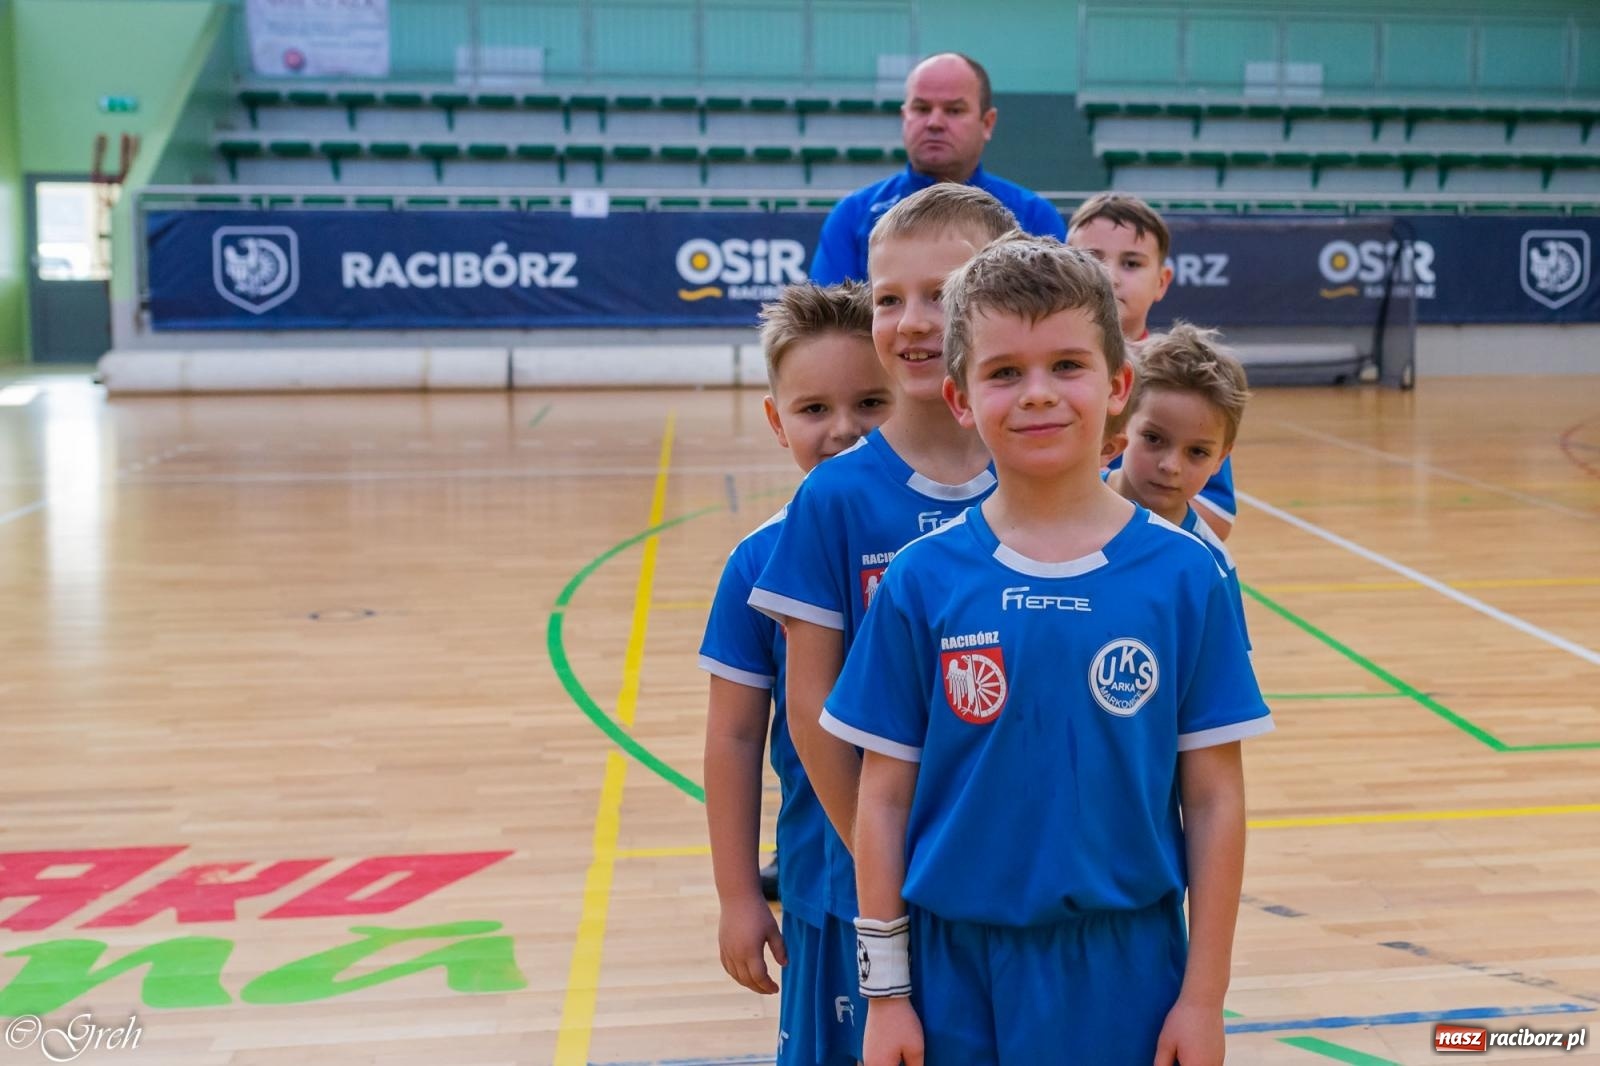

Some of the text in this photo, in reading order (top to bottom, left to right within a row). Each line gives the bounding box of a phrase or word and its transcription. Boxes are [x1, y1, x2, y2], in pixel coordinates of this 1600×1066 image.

[341, 241, 579, 289] RACIBÓRZ
[940, 630, 1000, 650] RACIBÓRZ
[1098, 646, 1153, 691] UKS
[1110, 681, 1136, 694] ARKA
